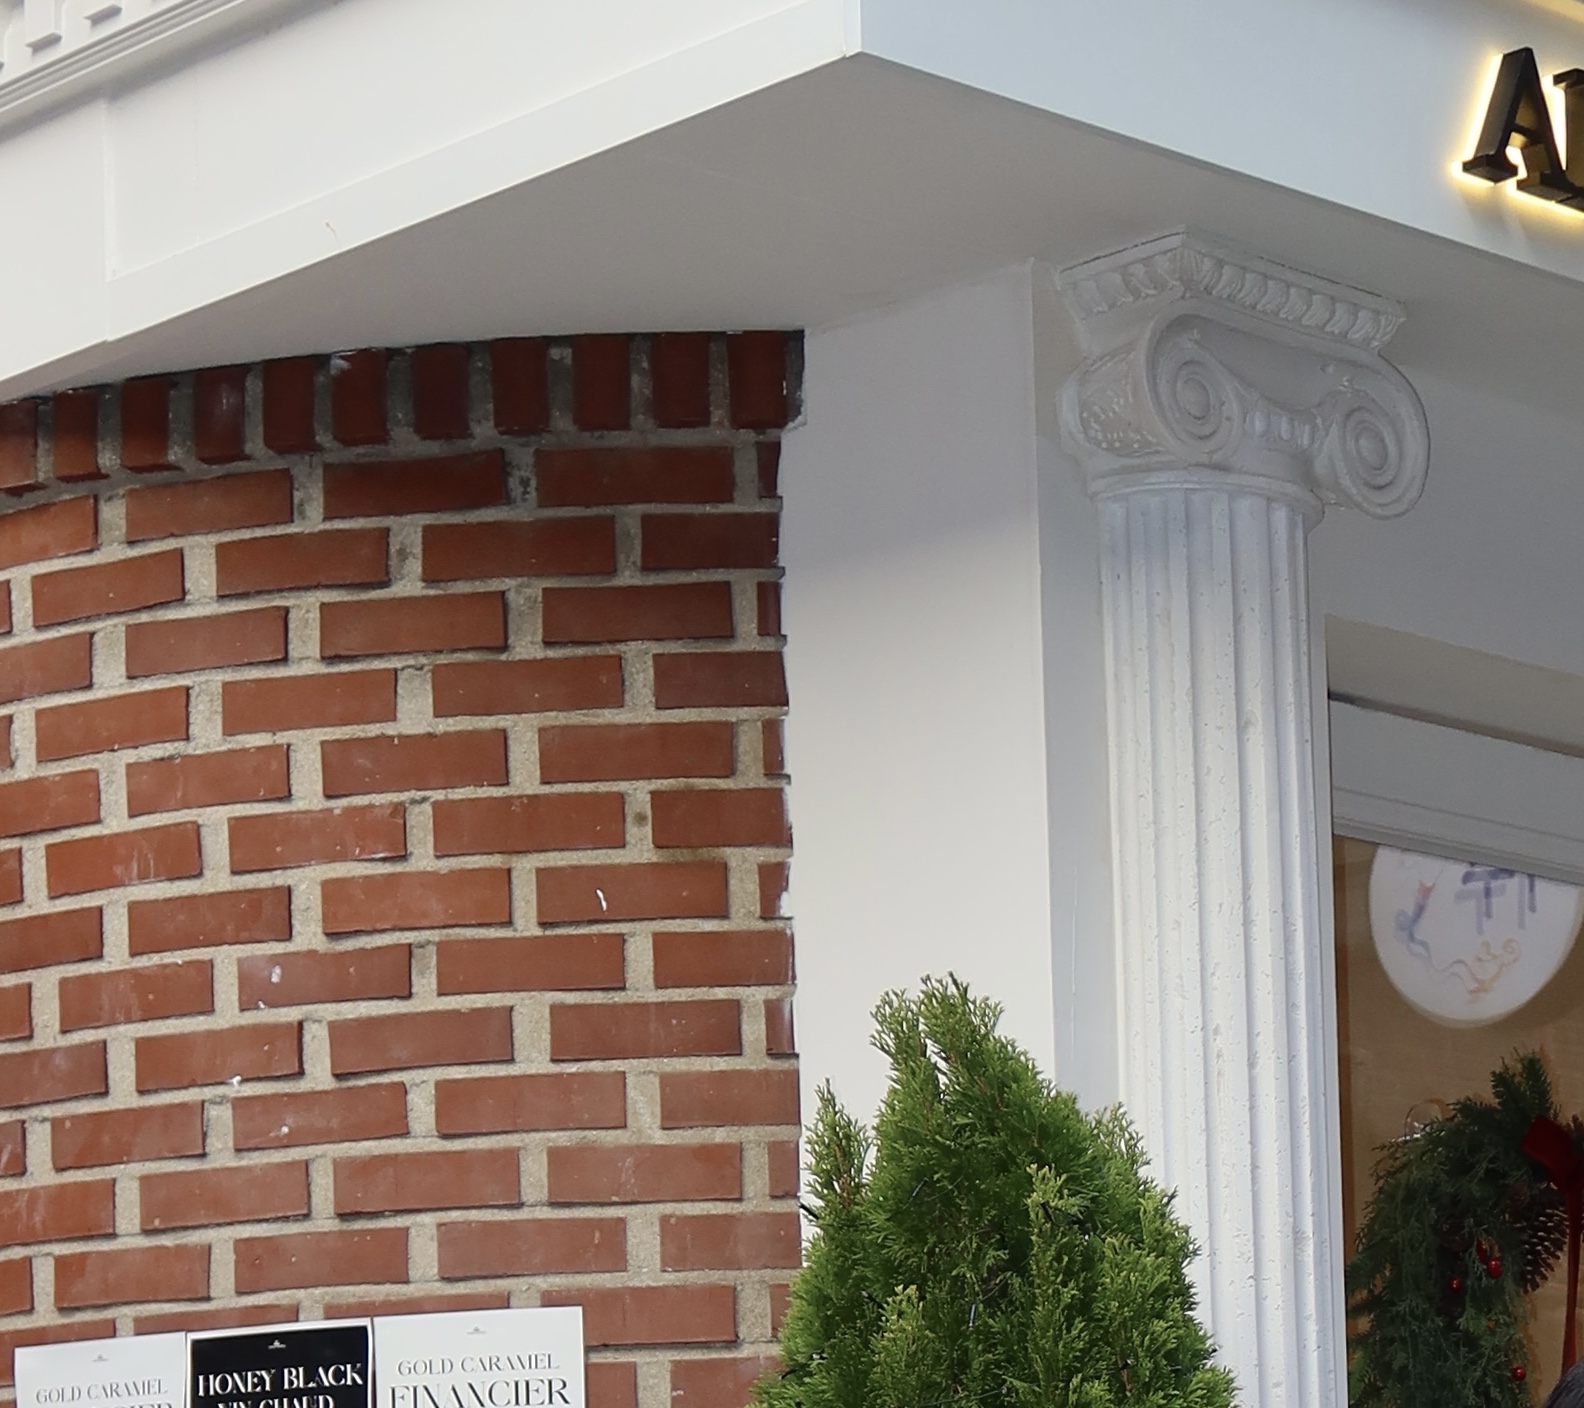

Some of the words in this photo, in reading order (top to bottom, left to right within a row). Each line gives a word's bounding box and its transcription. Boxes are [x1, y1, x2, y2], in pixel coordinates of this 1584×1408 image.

[397, 1358, 453, 1376] GOLD
[461, 1353, 560, 1373] CARAMEL
[36, 1386, 81, 1404] GOLD
[87, 1378, 168, 1400] CARAMEL
[198, 1369, 276, 1397] HONEY
[283, 1363, 363, 1390] BLACK
